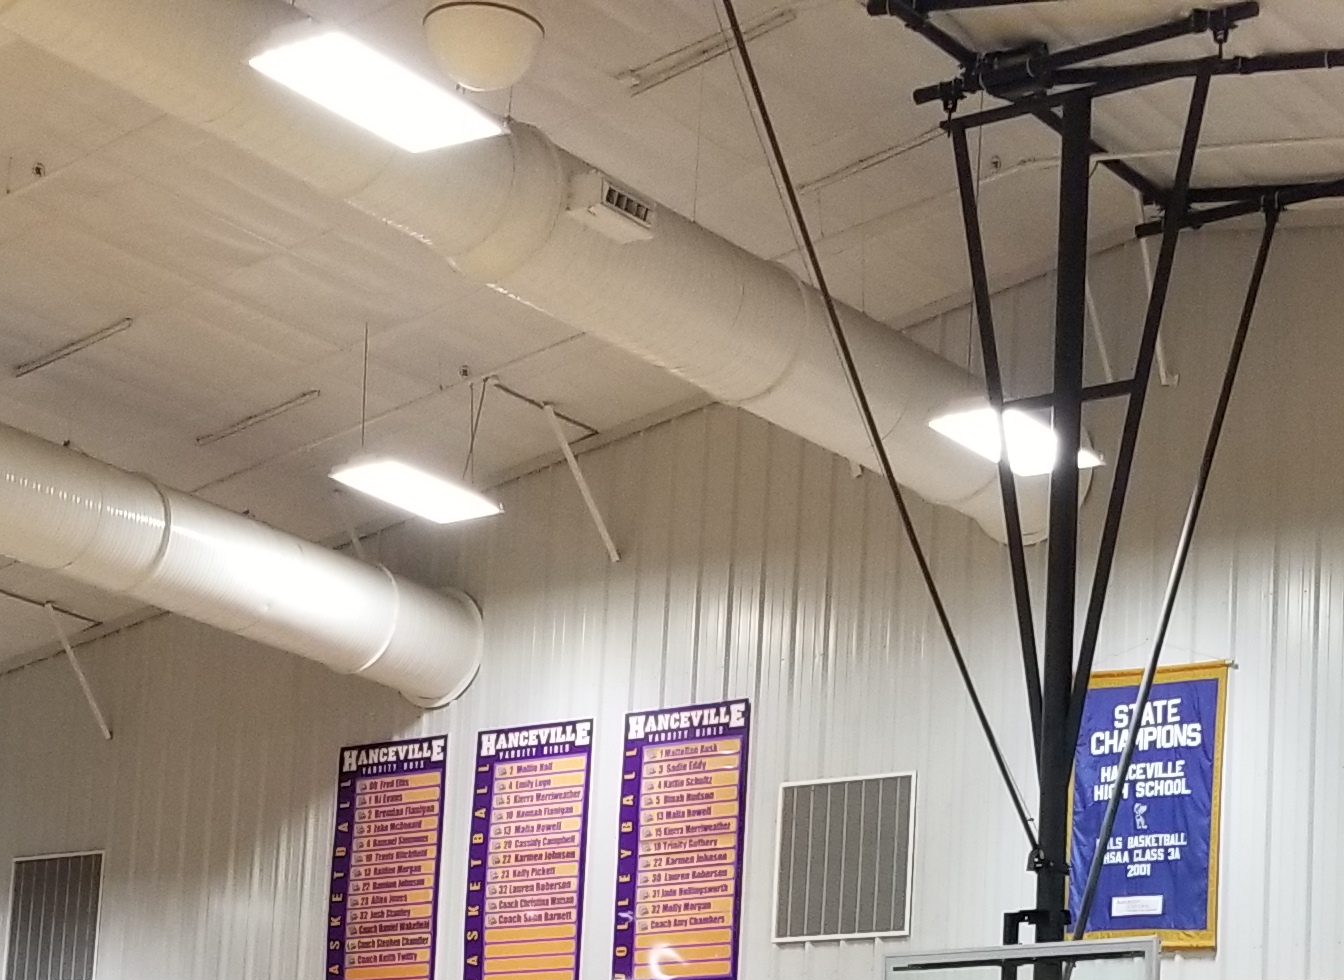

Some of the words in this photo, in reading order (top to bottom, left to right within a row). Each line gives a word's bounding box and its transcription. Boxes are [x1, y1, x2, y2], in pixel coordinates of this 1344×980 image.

[628, 702, 745, 740] HANCEVILLE
[481, 722, 590, 756] HANCEVILLE
[649, 730, 688, 742] VARSITY
[343, 738, 445, 772] HANCEVILLE
[1136, 778, 1192, 798] SCHOOL
[1127, 833, 1187, 849] BASKETBALL
[1133, 849, 1164, 862] CLASS
[1168, 847, 1180, 860] 3A
[1127, 863, 1151, 877] 2001
[499, 915, 521, 924] Coach
